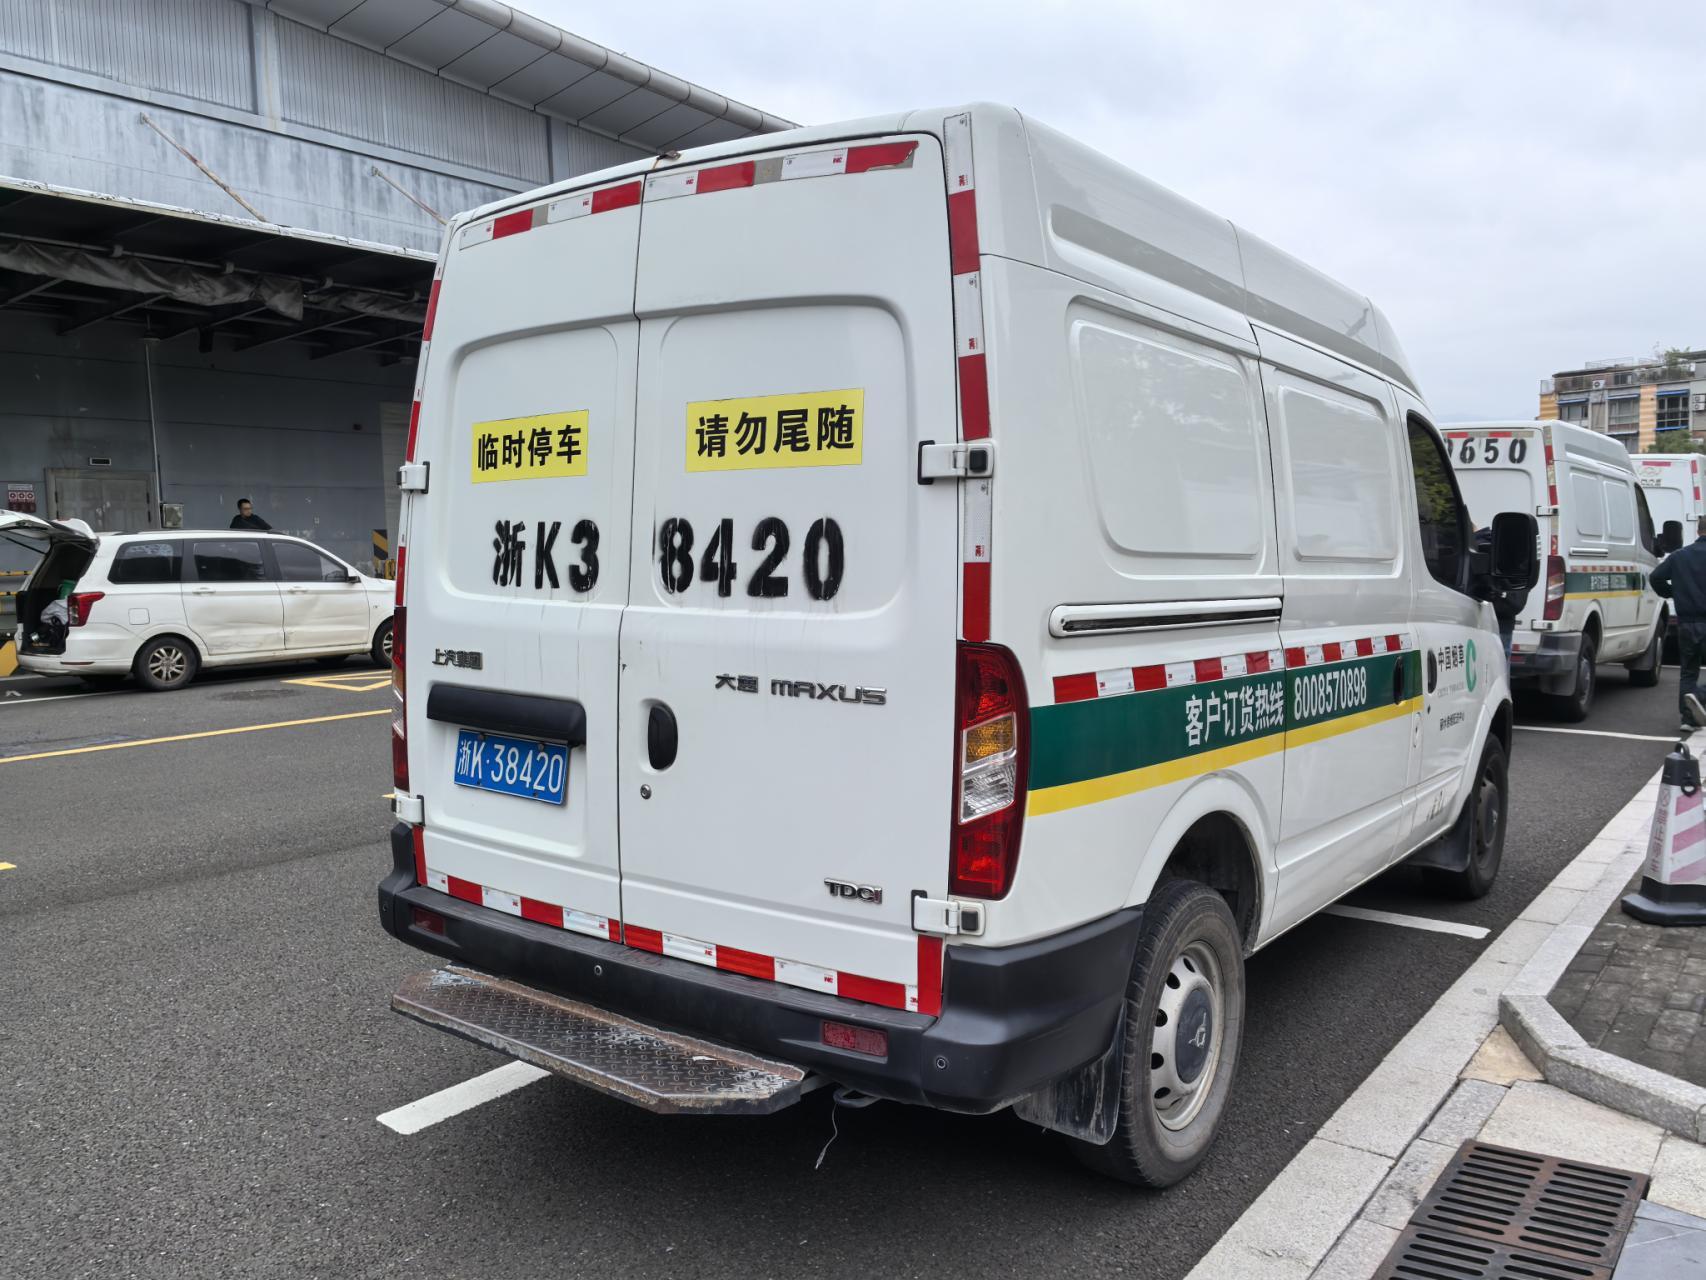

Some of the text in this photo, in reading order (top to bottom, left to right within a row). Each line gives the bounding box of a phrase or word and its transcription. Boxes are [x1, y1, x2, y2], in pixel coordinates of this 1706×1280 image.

[477, 404, 855, 471] 临时停车 请勿尾随
[493, 516, 845, 600] 浙K3 8420
[771, 679, 888, 705] MAXUS
[1185, 666, 1367, 747] 客户订货热线 8008570898
